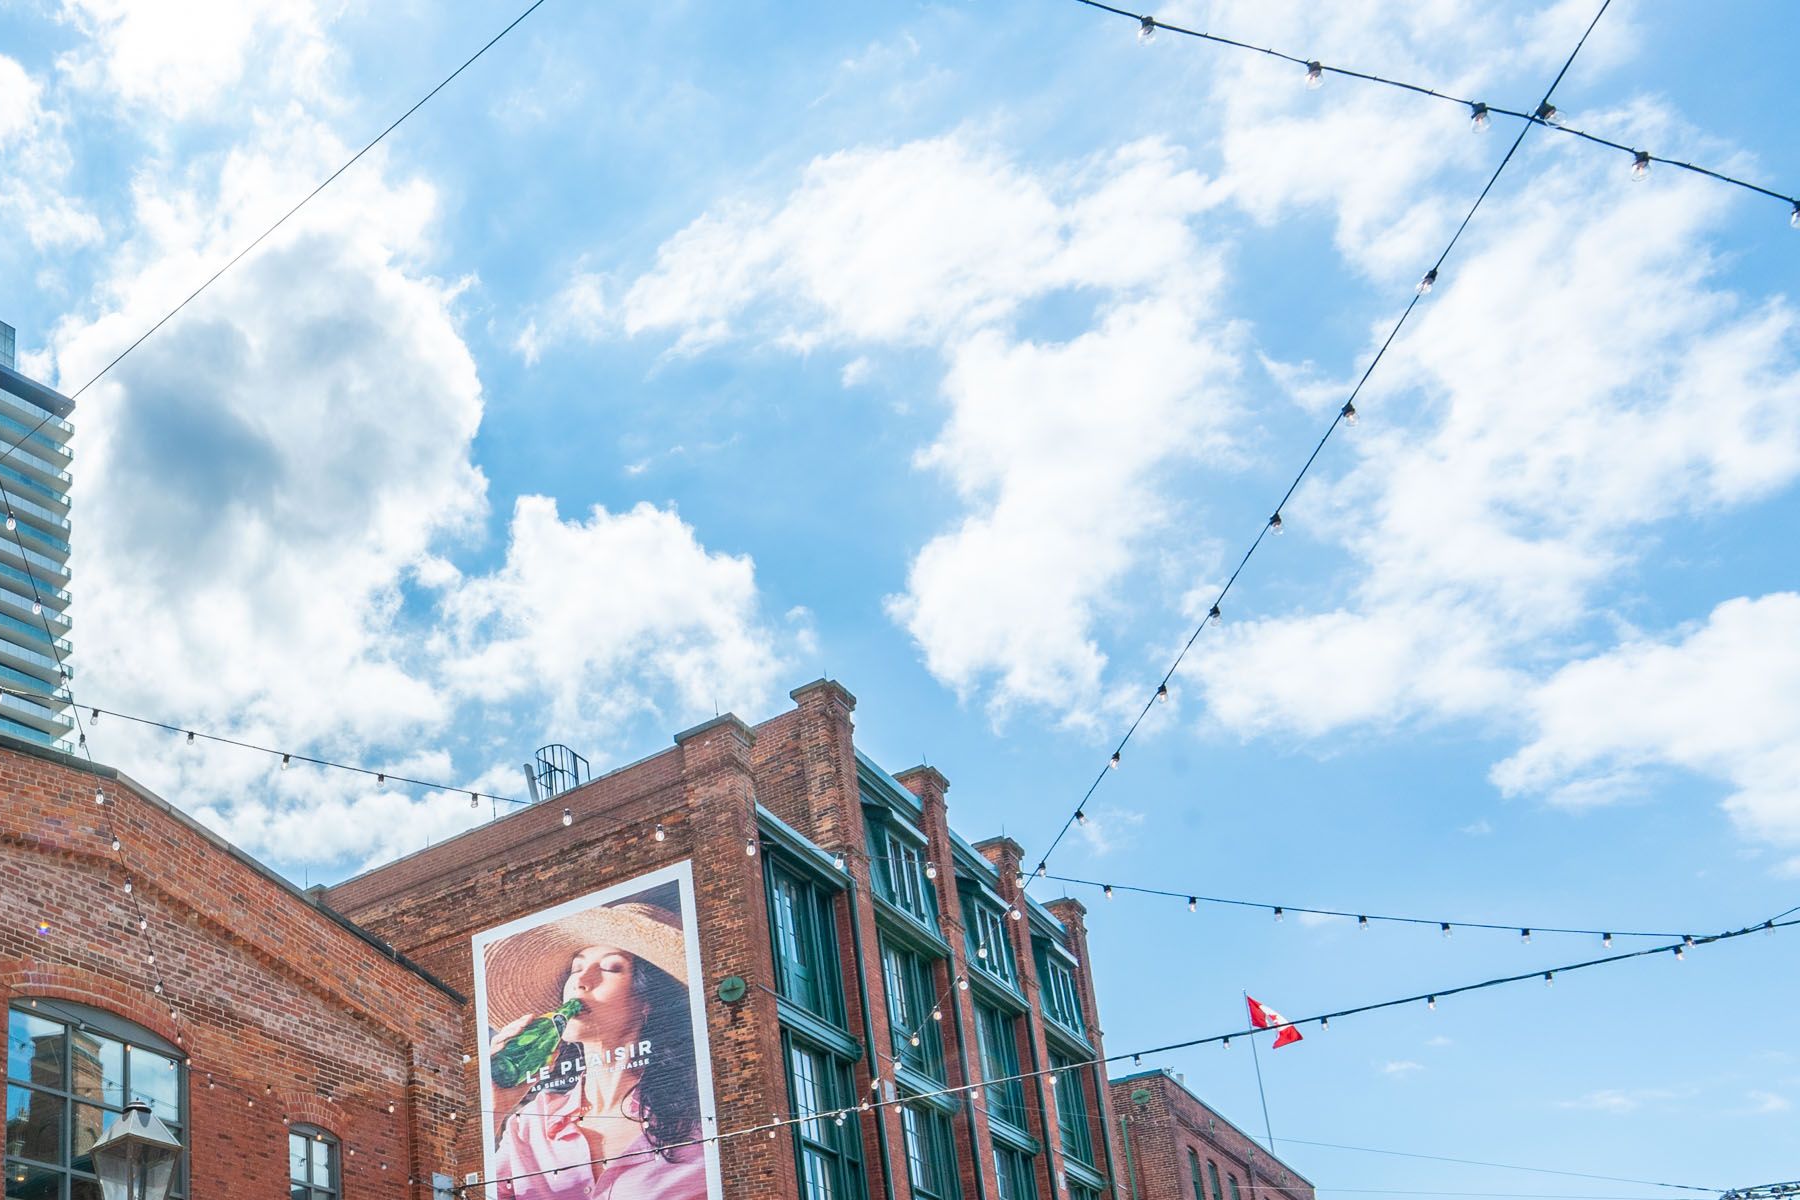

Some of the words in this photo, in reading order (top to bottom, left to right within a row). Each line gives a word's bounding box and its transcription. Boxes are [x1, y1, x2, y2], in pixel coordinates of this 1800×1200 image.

[526, 1066, 550, 1084] LE
[561, 1040, 653, 1075] PLAISIR
[545, 1079, 566, 1089] SEEN
